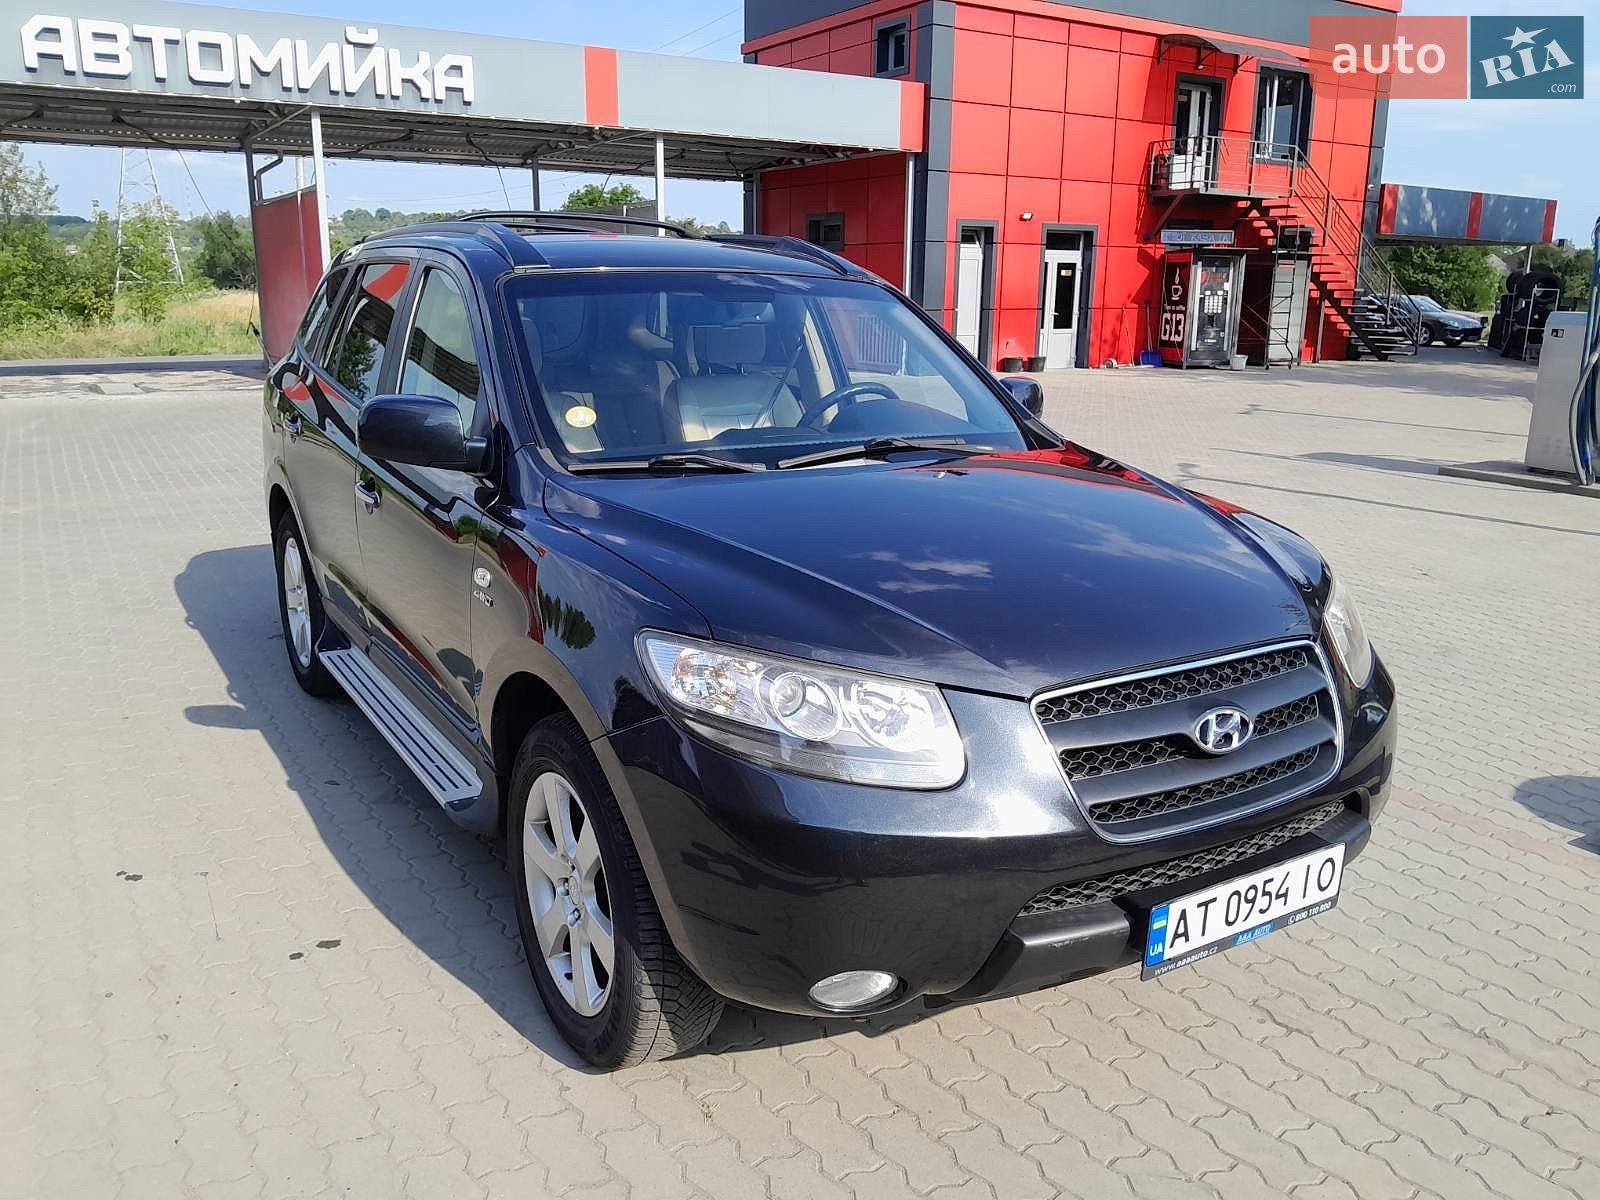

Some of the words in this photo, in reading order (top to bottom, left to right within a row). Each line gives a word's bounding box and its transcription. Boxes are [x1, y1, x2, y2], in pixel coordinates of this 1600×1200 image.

[20, 14, 474, 105] АВТОМИЙКА
[1161, 313, 1184, 342] G13
[1169, 897, 1217, 949] AT
[1225, 871, 1290, 927] 0954
[1303, 857, 1336, 899] IO
[1150, 943, 1163, 957] UA
